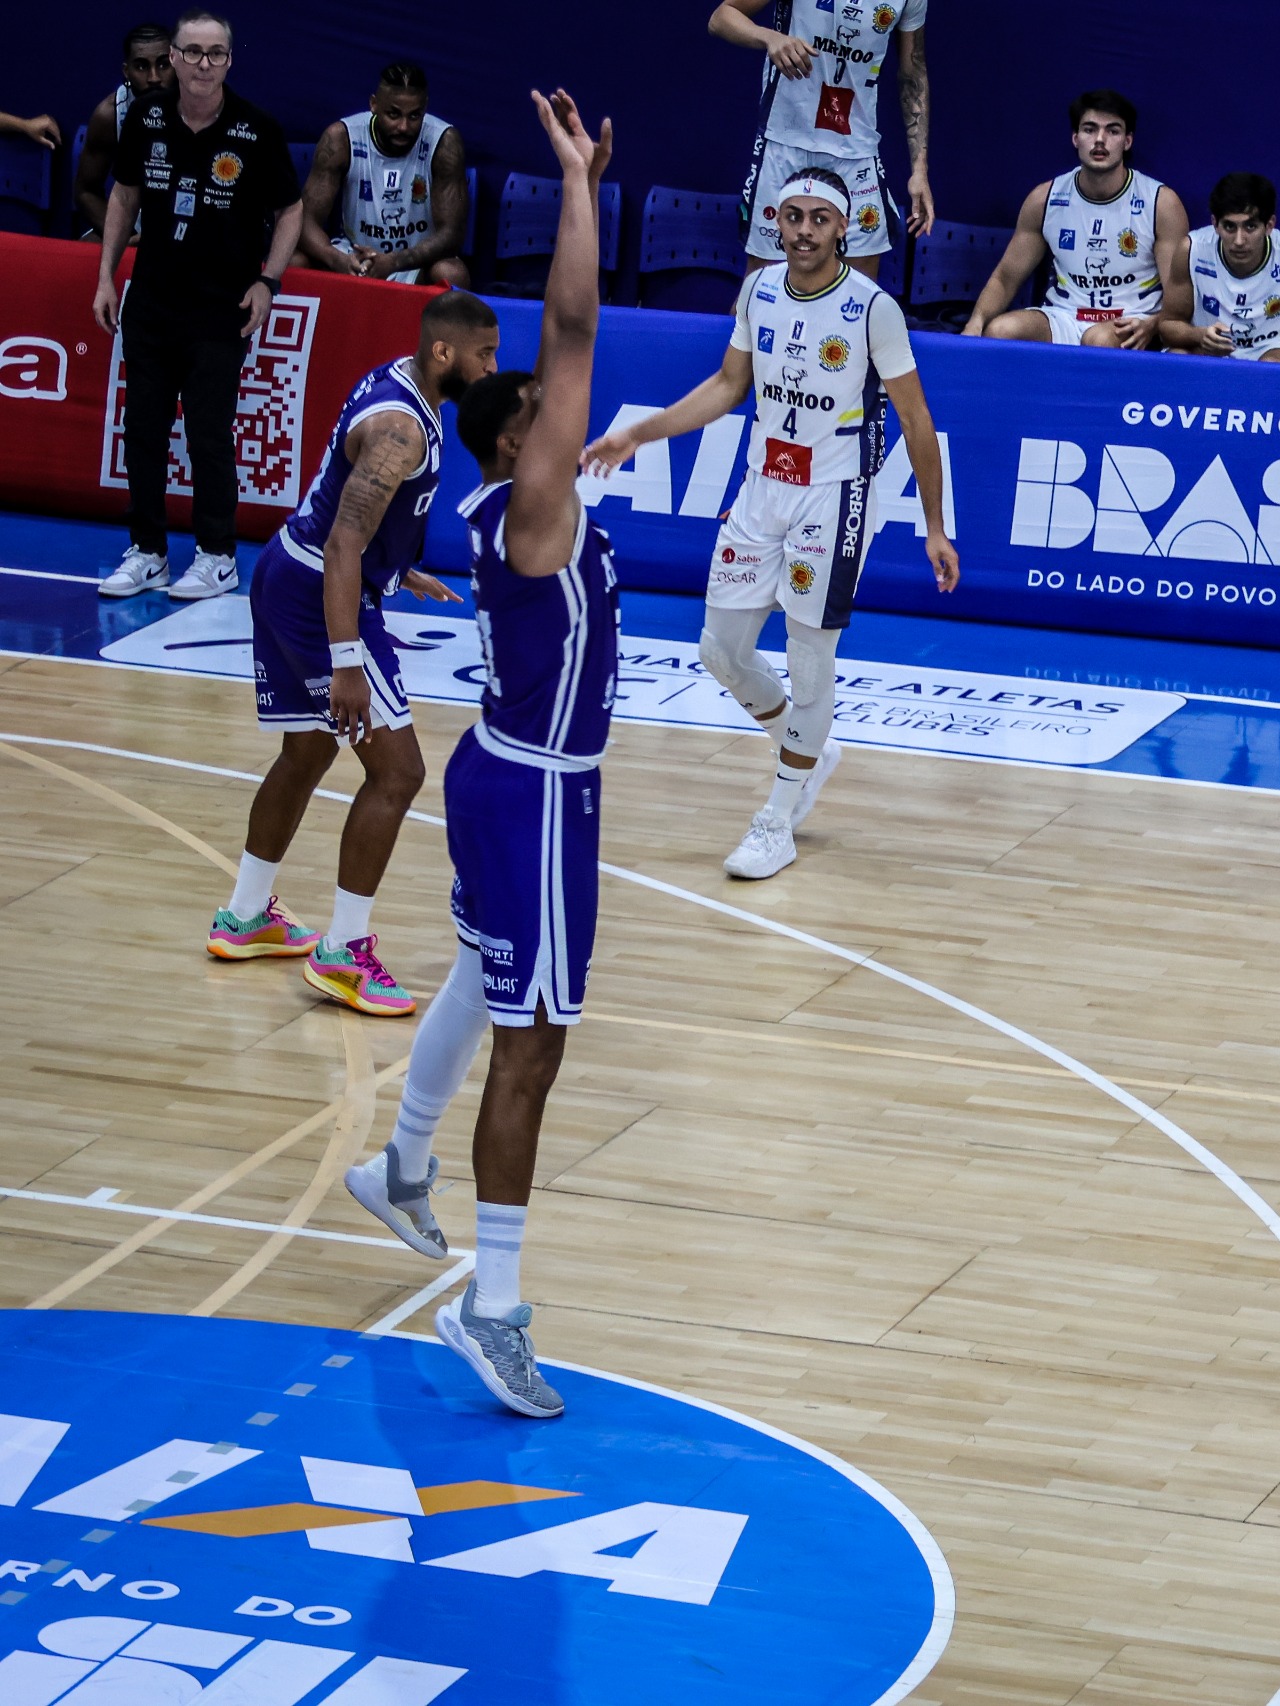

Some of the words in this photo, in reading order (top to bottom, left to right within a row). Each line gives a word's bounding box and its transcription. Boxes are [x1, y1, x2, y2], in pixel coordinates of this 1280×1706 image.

[782, 408, 798, 440] 4
[717, 571, 757, 584] OSCAR
[1027, 569, 1065, 588] DO
[1076, 573, 1146, 596] LADO
[1156, 580, 1194, 600] DO
[1205, 584, 1277, 606] POVO
[886, 682, 1126, 714] ATLETAS
[885, 706, 1092, 736] BRASILEIRO
[233, 1595, 352, 1626] DO
